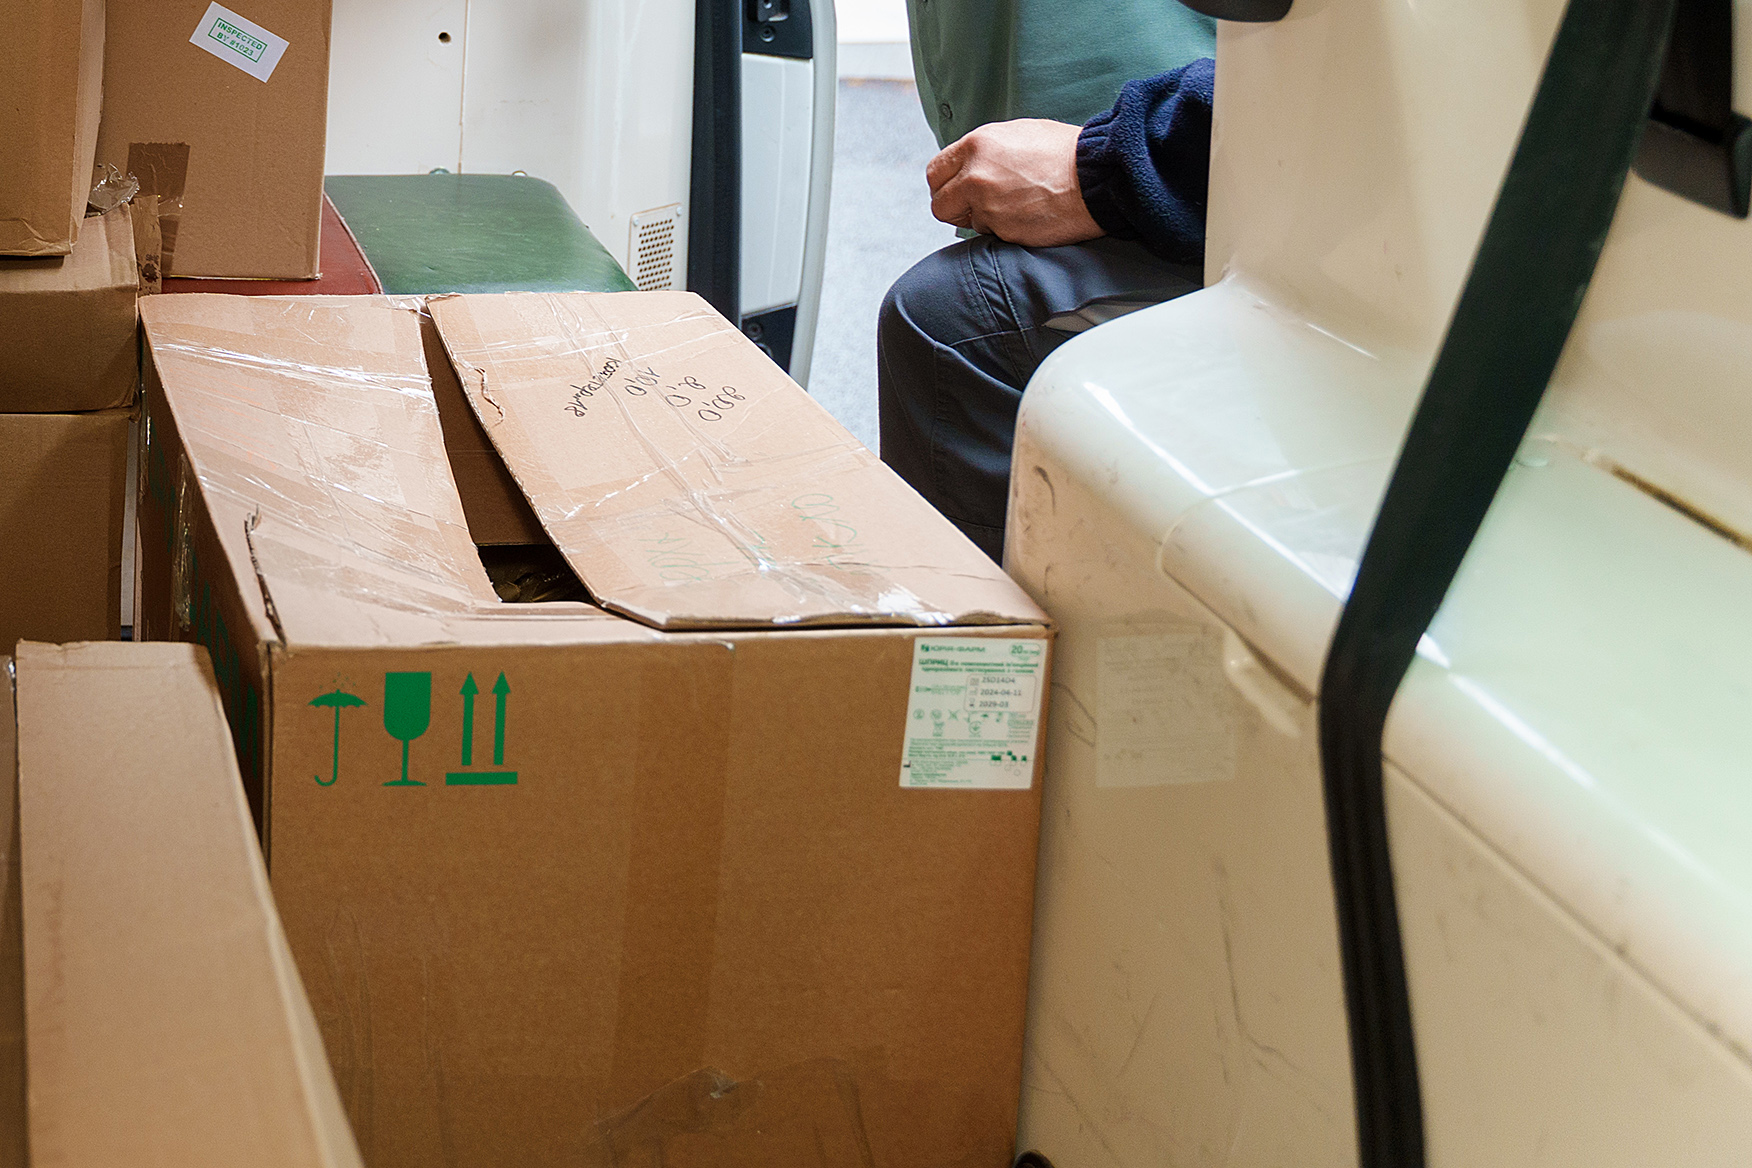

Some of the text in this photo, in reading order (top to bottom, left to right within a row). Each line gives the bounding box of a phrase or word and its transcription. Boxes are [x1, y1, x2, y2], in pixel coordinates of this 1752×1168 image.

[216, 32, 254, 56] BY #1023
[217, 21, 263, 51] INSPECTED
[1011, 645, 1023, 654] 20
